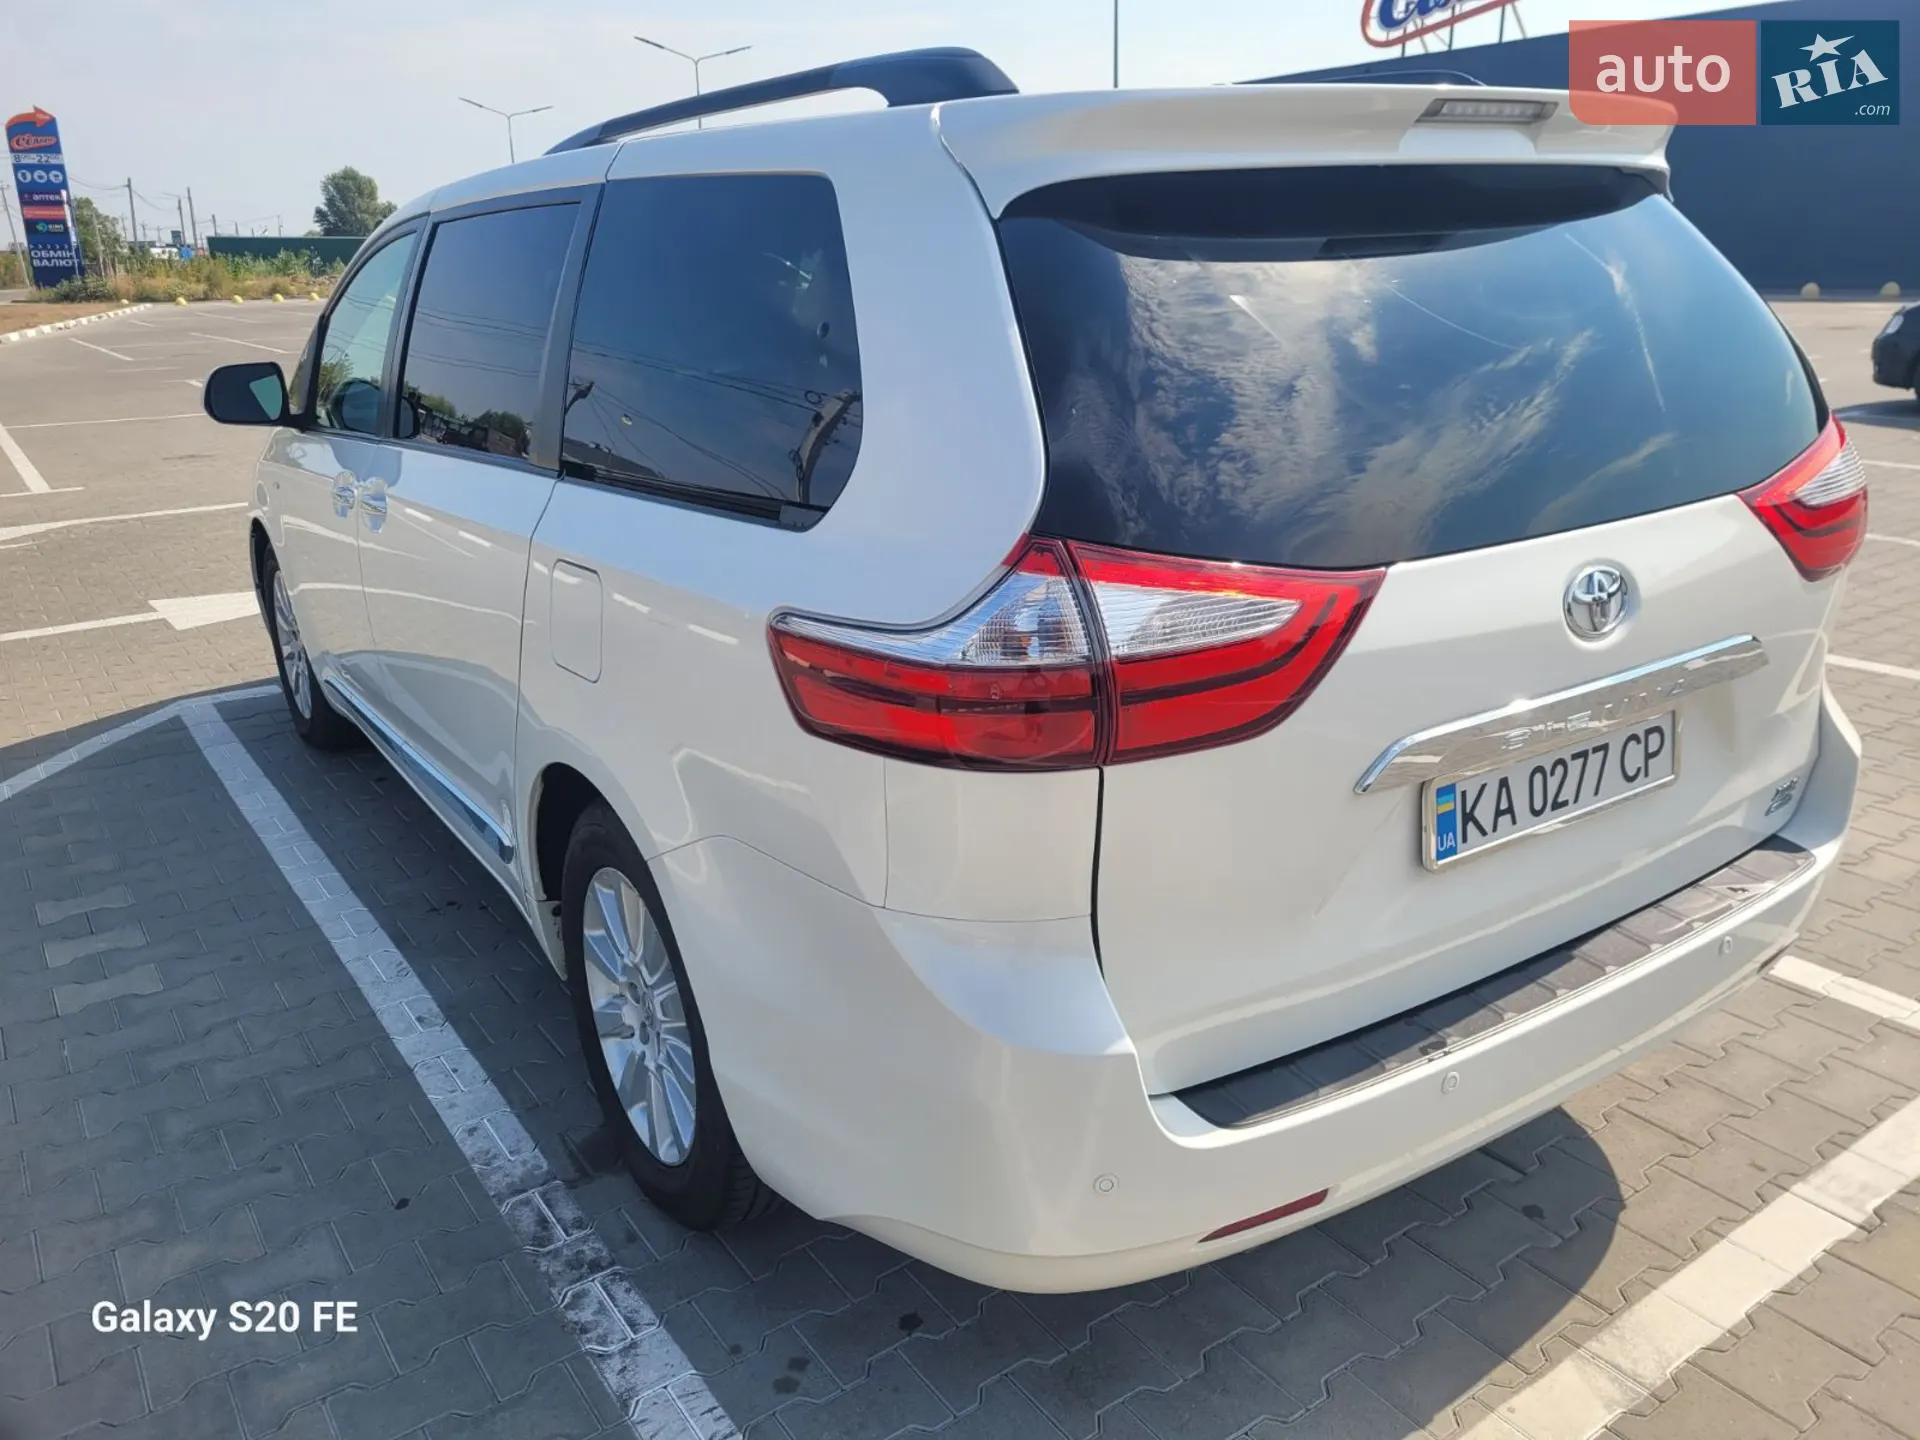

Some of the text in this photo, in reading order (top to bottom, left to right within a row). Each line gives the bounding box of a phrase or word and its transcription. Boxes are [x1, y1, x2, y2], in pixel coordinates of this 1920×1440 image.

[31, 249, 74, 258] ОБМІН
[33, 258, 79, 267] ВАЛЮТ
[1461, 724, 1665, 846] KA 0277 CP
[1437, 831, 1456, 852] UA
